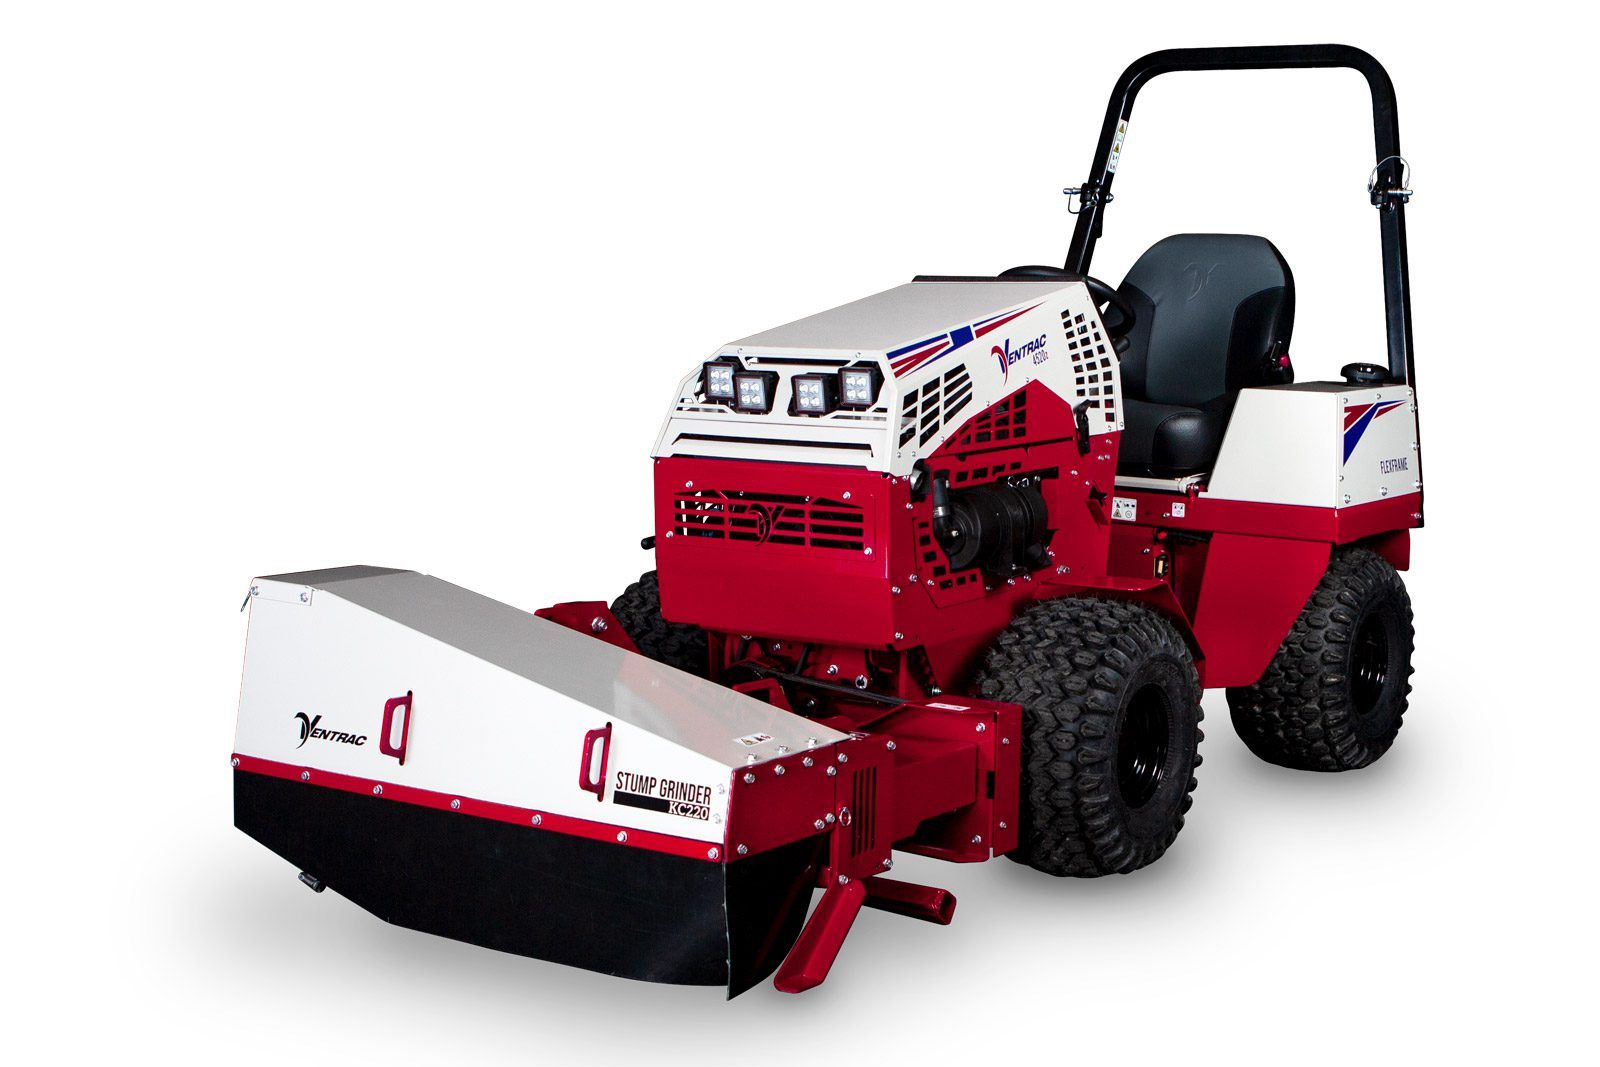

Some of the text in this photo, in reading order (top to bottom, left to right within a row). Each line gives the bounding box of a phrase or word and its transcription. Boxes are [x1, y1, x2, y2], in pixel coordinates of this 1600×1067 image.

[991, 334, 1046, 385] VENTRAC
[1380, 457, 1408, 474] FLEXFRAME
[294, 711, 368, 749] VENTRAC
[616, 771, 711, 806] STUMP GRINDER
[668, 800, 708, 820] KC220
